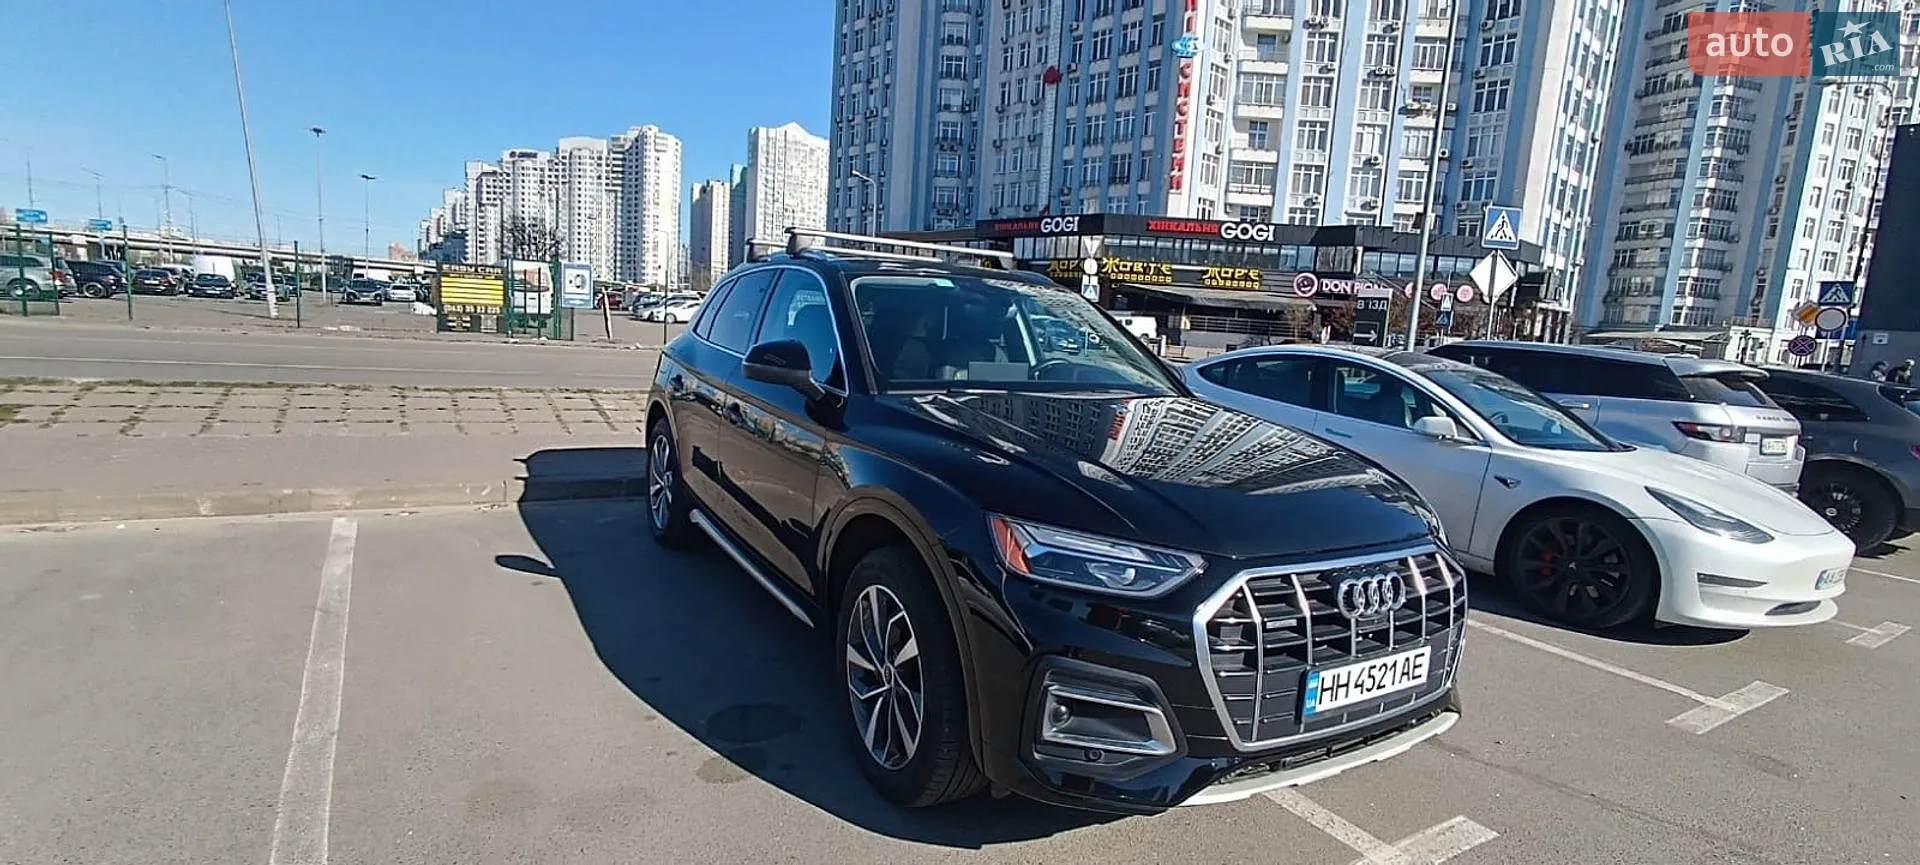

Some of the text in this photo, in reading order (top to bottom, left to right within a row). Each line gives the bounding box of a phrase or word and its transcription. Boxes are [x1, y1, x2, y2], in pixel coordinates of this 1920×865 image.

[1041, 216, 1079, 233] GOGI
[1221, 222, 1276, 242] GOGI
[1322, 280, 1352, 294] DON
[1319, 670, 1351, 705] HH
